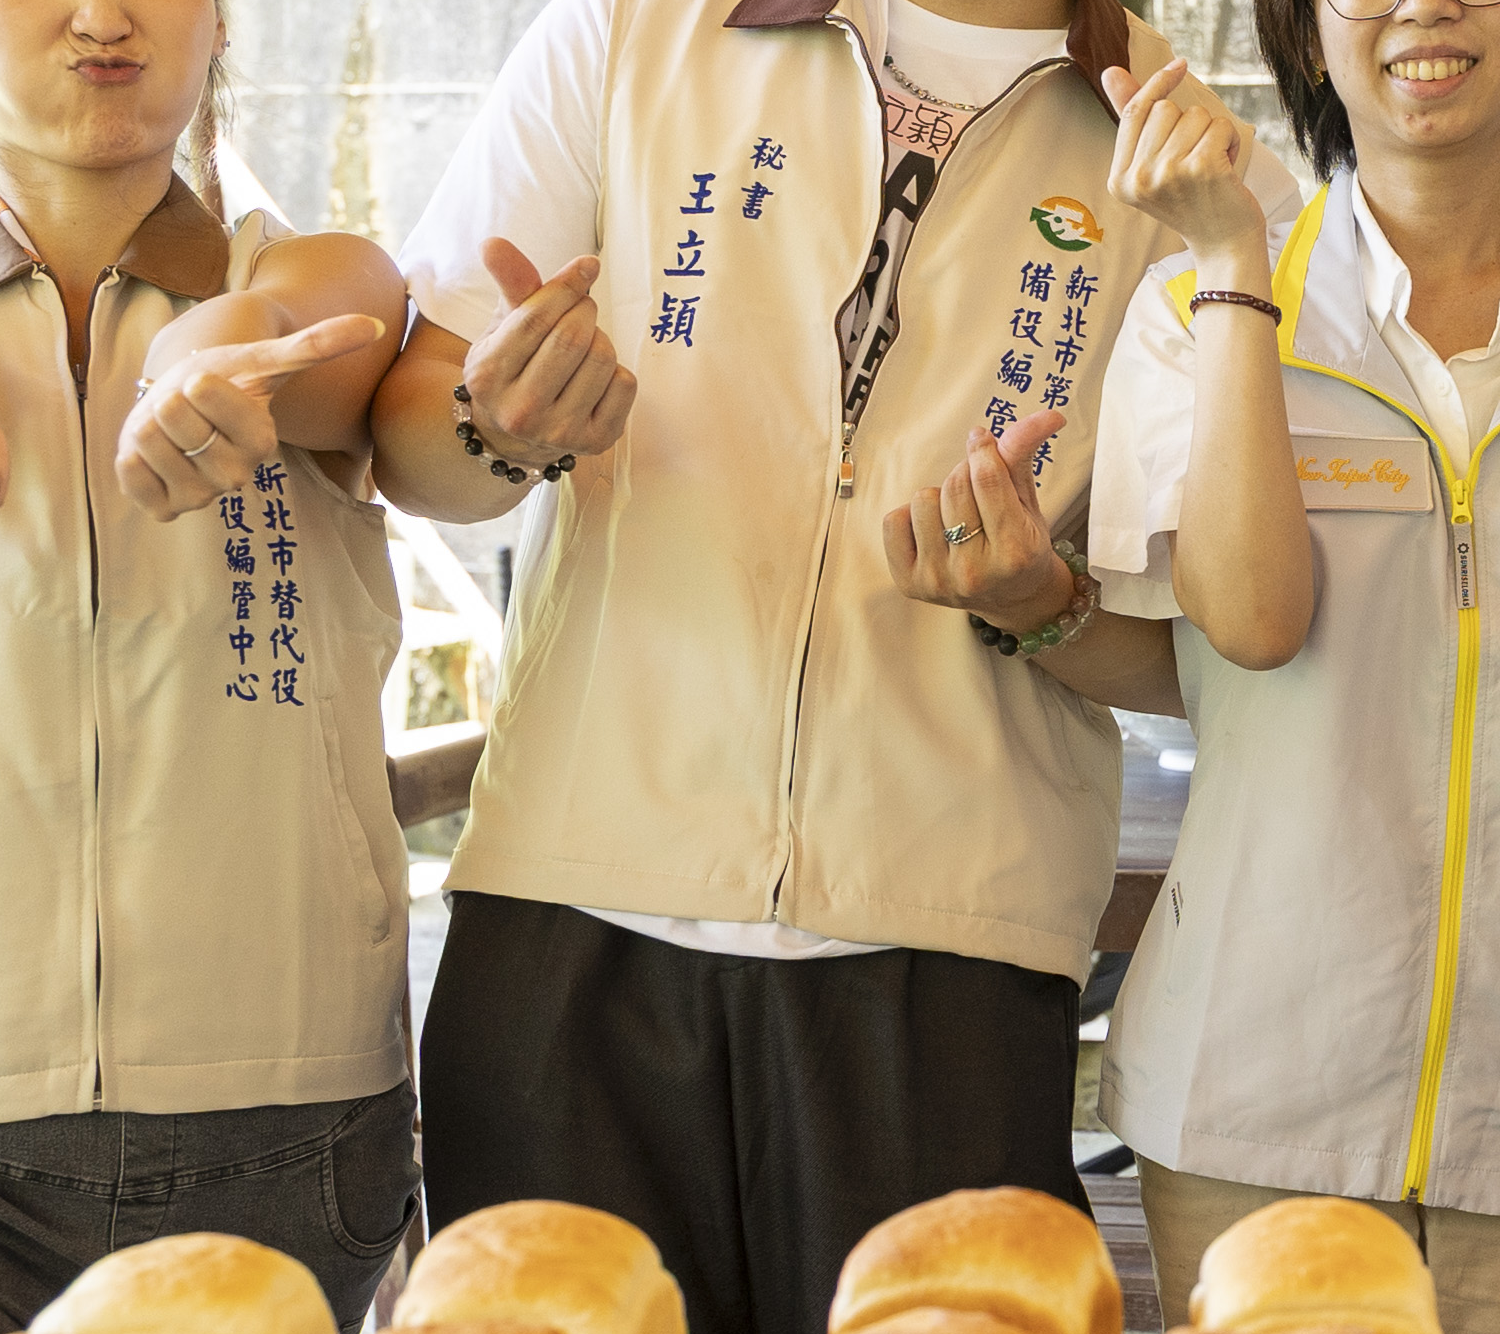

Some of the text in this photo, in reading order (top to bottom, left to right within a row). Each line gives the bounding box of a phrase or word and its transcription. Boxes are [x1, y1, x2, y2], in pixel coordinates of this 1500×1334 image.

[650, 172, 716, 348] 王立穎
[741, 137, 787, 220] 秘書
[219, 487, 260, 702] 役編管中心
[252, 463, 305, 707] 新北市替代役
